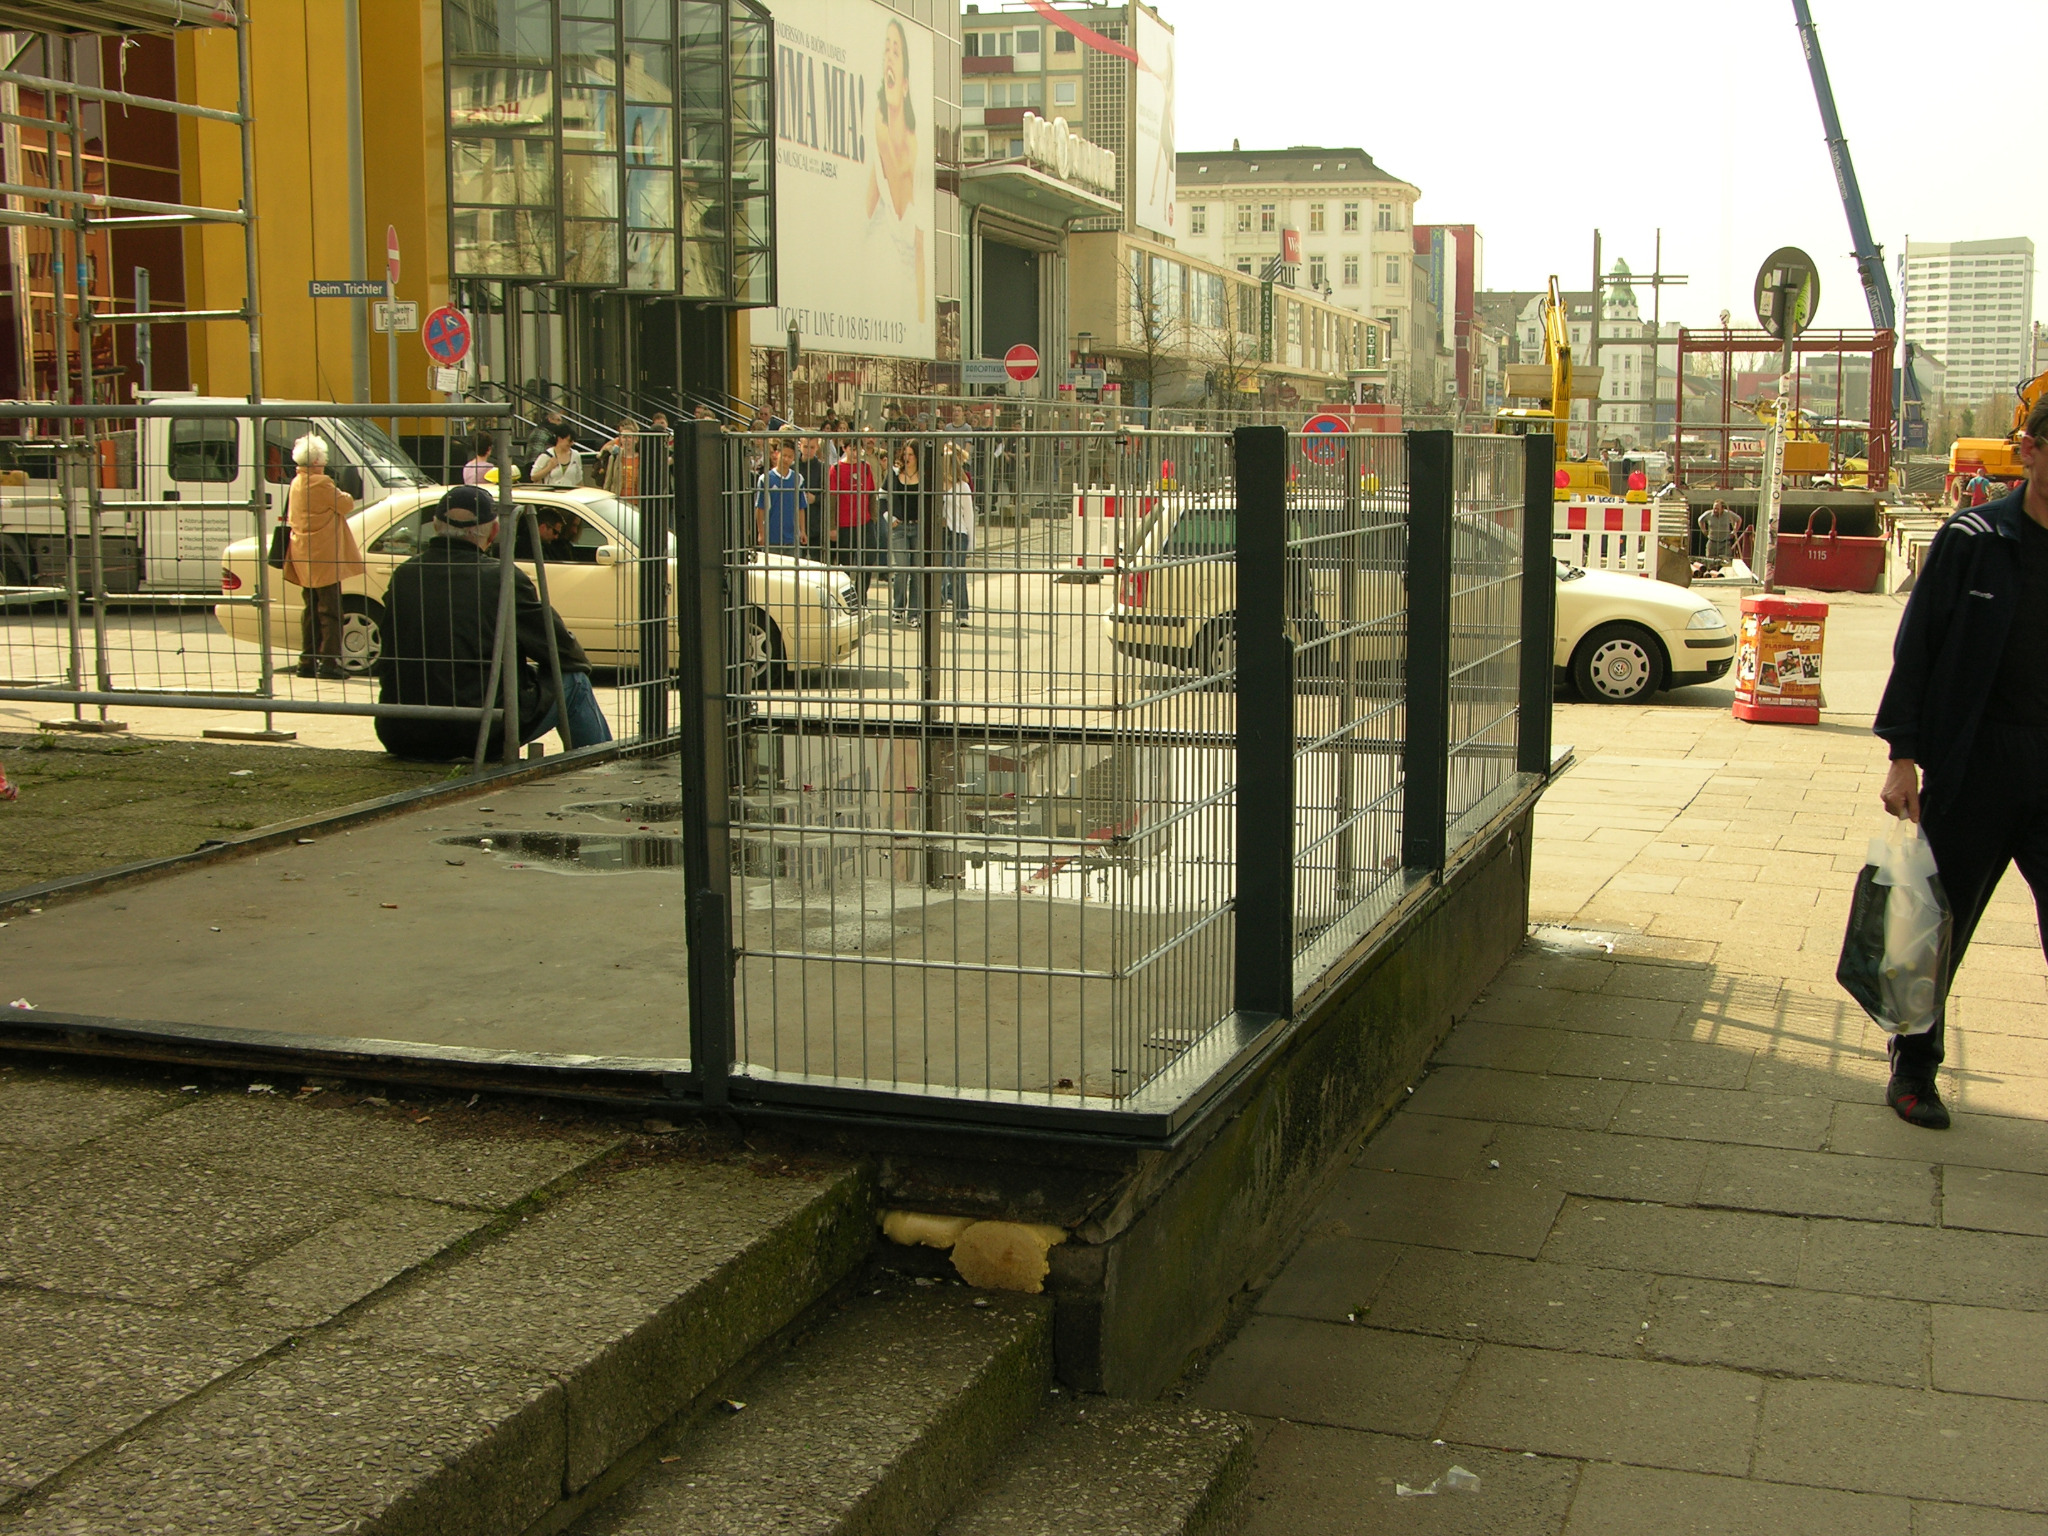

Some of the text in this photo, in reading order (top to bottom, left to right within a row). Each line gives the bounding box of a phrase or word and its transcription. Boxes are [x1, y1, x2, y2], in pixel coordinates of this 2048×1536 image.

[822, 61, 866, 165] MIA!
[783, 149, 809, 172] MUSICAL
[313, 283, 383, 295] Beim Trichter
[380, 305, 414, 313] Feuwehr-
[775, 306, 810, 334] TICKET
[814, 310, 835, 337] LINE
[1263, 290, 1271, 362] BILLARD SALON
[1368, 327, 1376, 366] HOTE
[1808, 550, 1827, 560] 1115
[1780, 621, 1820, 634] JUMP
[1792, 633, 1820, 642] OFF
